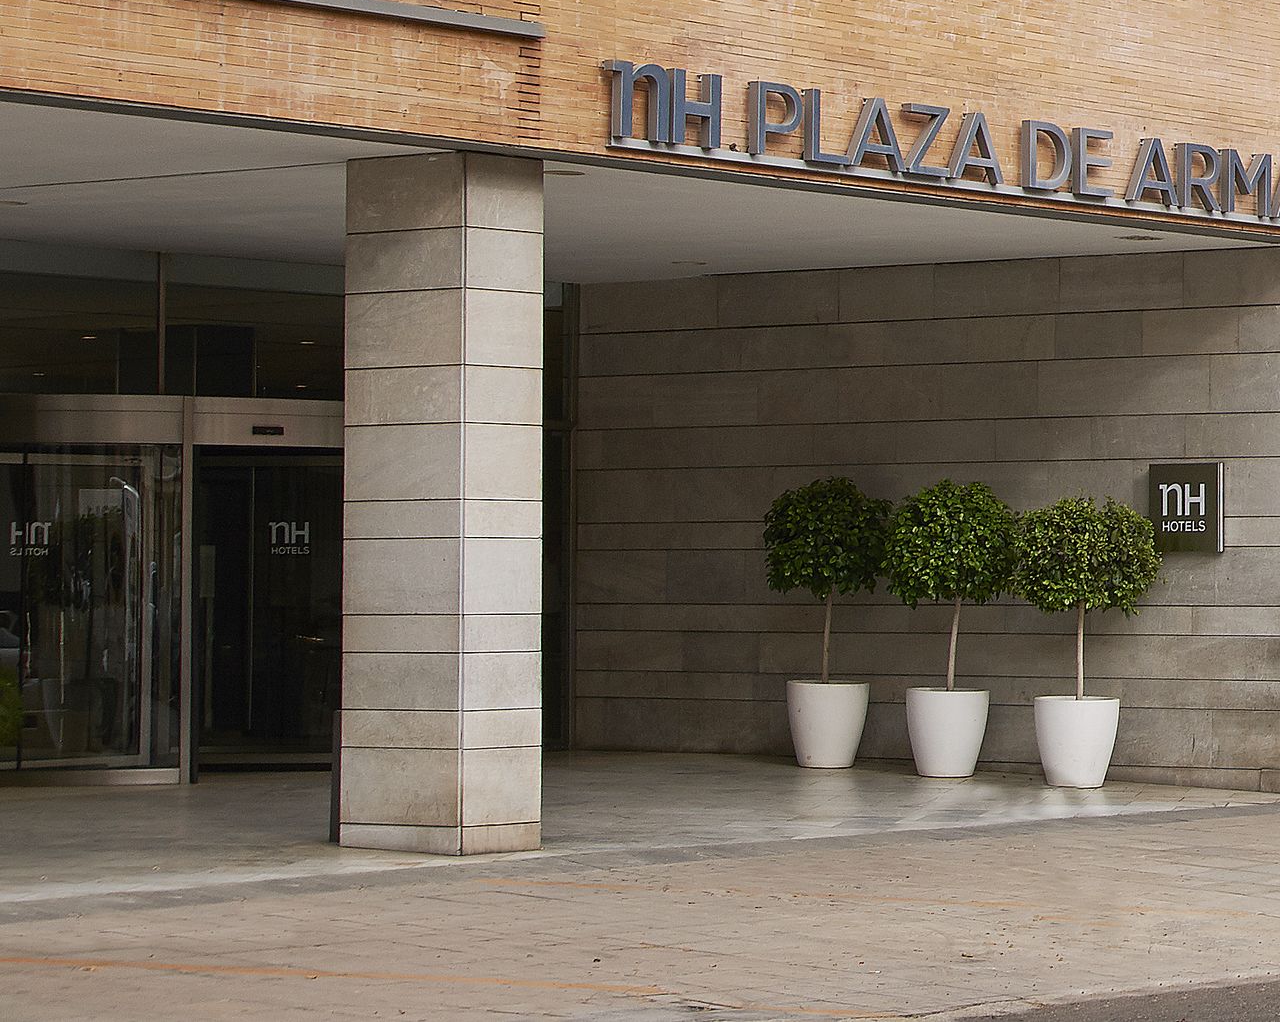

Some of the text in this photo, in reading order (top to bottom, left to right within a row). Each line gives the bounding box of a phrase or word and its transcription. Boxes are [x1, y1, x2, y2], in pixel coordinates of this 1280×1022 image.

[749, 80, 1004, 186] PLAZA
[1021, 119, 1114, 198] DE
[1162, 520, 1207, 532] HOTELS
[271, 546, 310, 555] HOTELS
